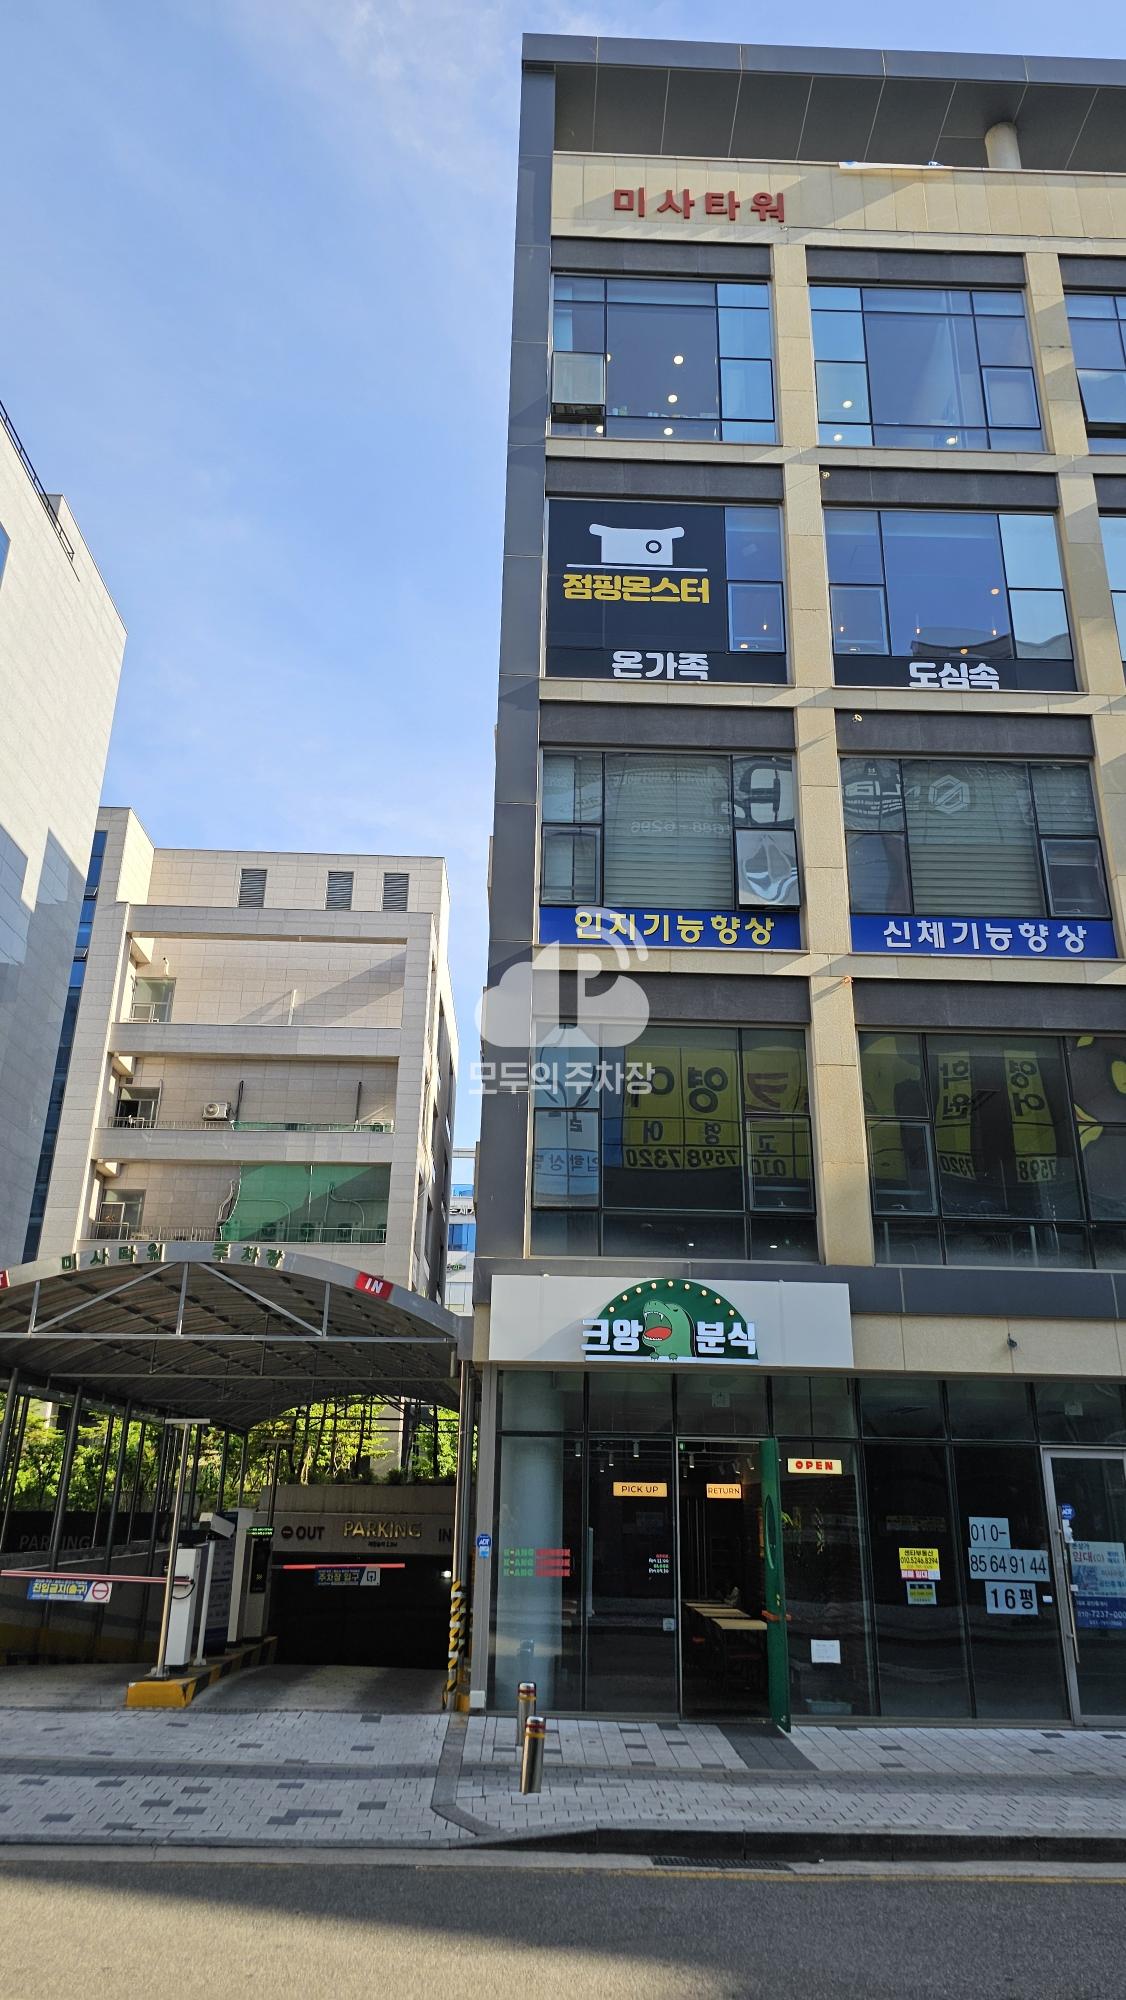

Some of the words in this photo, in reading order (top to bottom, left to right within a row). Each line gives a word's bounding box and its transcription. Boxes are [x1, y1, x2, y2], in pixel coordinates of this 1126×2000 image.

[614, 186, 785, 222] 미사타워
[563, 574, 710, 604] 점핑몬스터
[612, 650, 709, 680] 온가족
[909, 662, 1000, 690] 도심속
[574, 911, 775, 945] 인지기능향상
[883, 920, 1088, 953] 신체기능향상
[61, 1242, 165, 1271] 미사타워
[213, 1243, 285, 1268] 주차장
[364, 1277, 384, 1294] IN
[581, 1319, 644, 1352] 크앙
[696, 1320, 757, 1355] 분식
[795, 1460, 833, 1471] OPEN
[621, 1485, 643, 1494] PICK
[645, 1486, 659, 1494] UP
[707, 1487, 740, 1495] RETURN
[19, 1535, 92, 1550] PARING
[295, 1526, 326, 1540] OUT
[343, 1520, 422, 1539] PARKING
